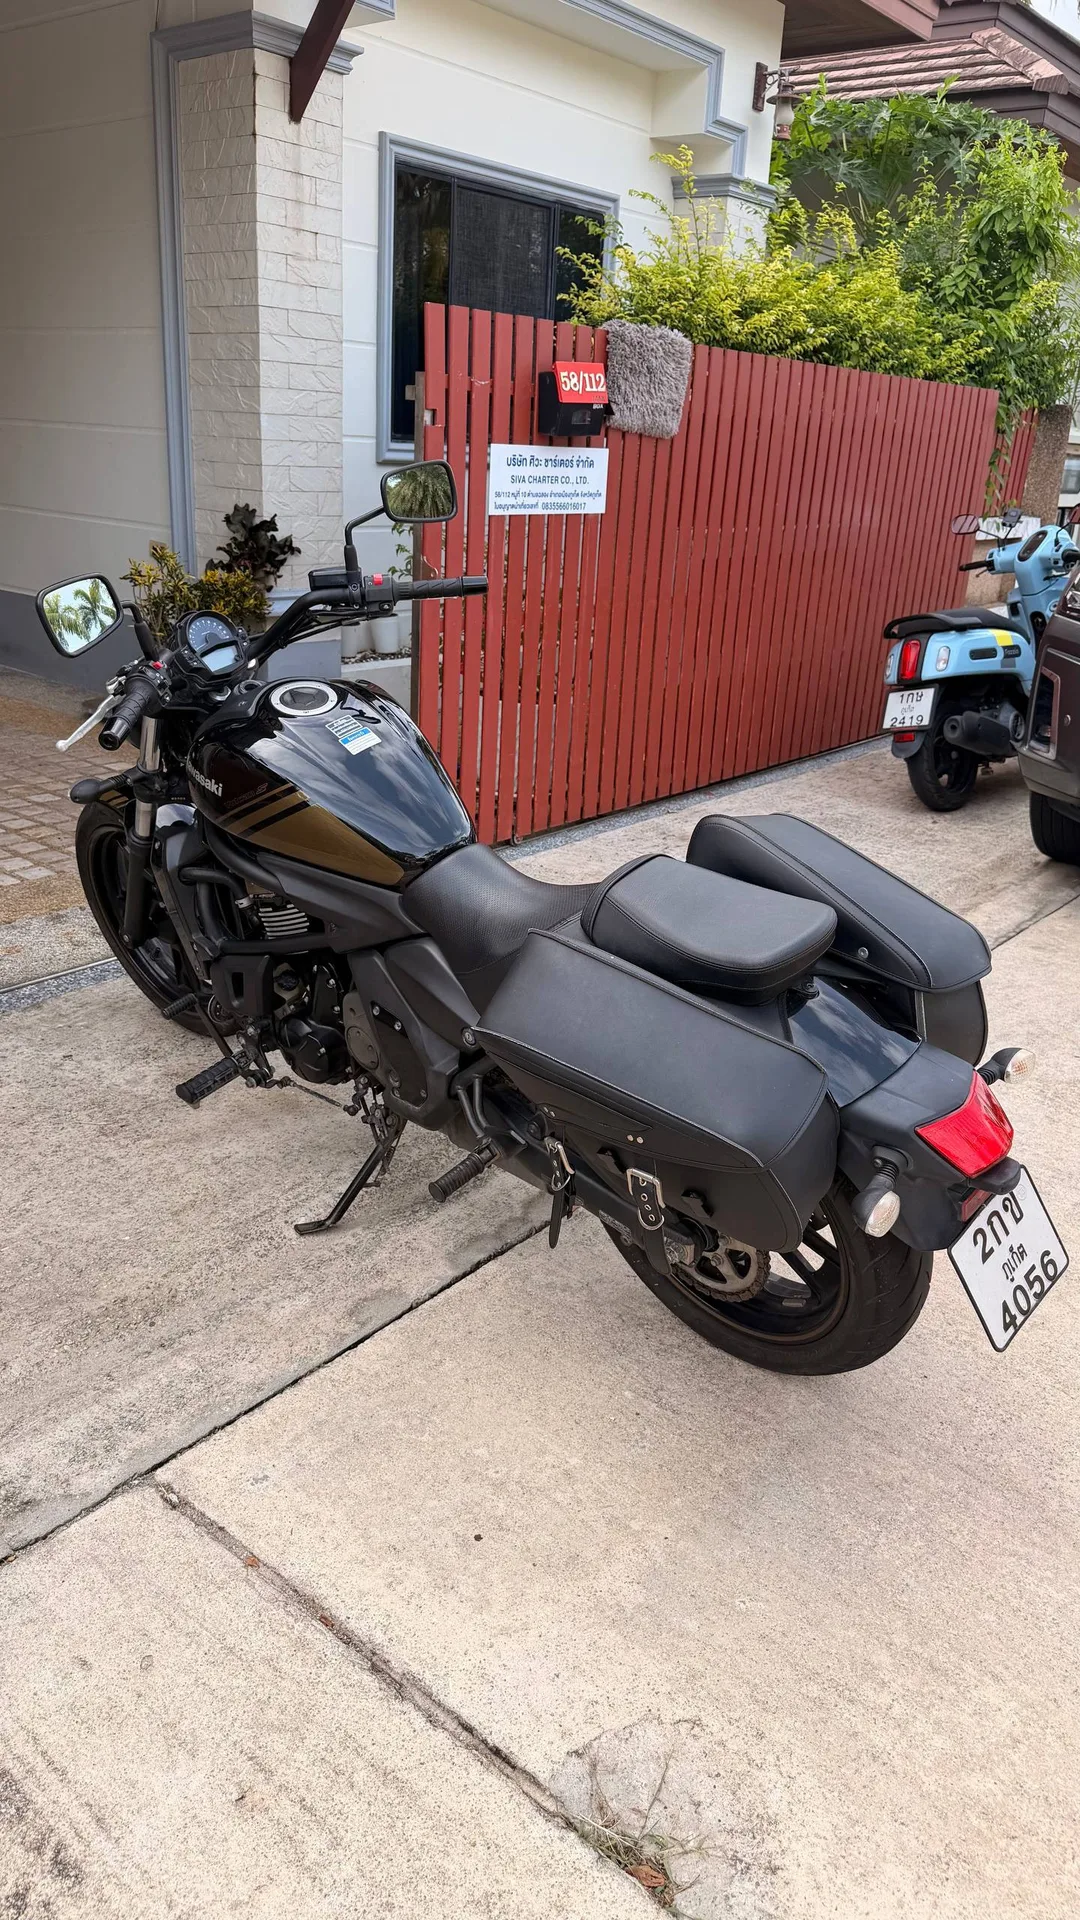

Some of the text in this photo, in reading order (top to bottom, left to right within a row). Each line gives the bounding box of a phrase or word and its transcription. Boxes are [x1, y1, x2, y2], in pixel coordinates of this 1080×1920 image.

[560, 370, 606, 395] 58/112
[506, 454, 595, 468] บริษัท ศิวะ ชาร์เตอร์ จำกัด
[510, 475, 589, 486] SIVA CHARTER CO., LTD.
[890, 714, 924, 727] 2419
[1001, 1243, 1028, 1283] ภูเก็ต
[1001, 1250, 1058, 1334] 4056
